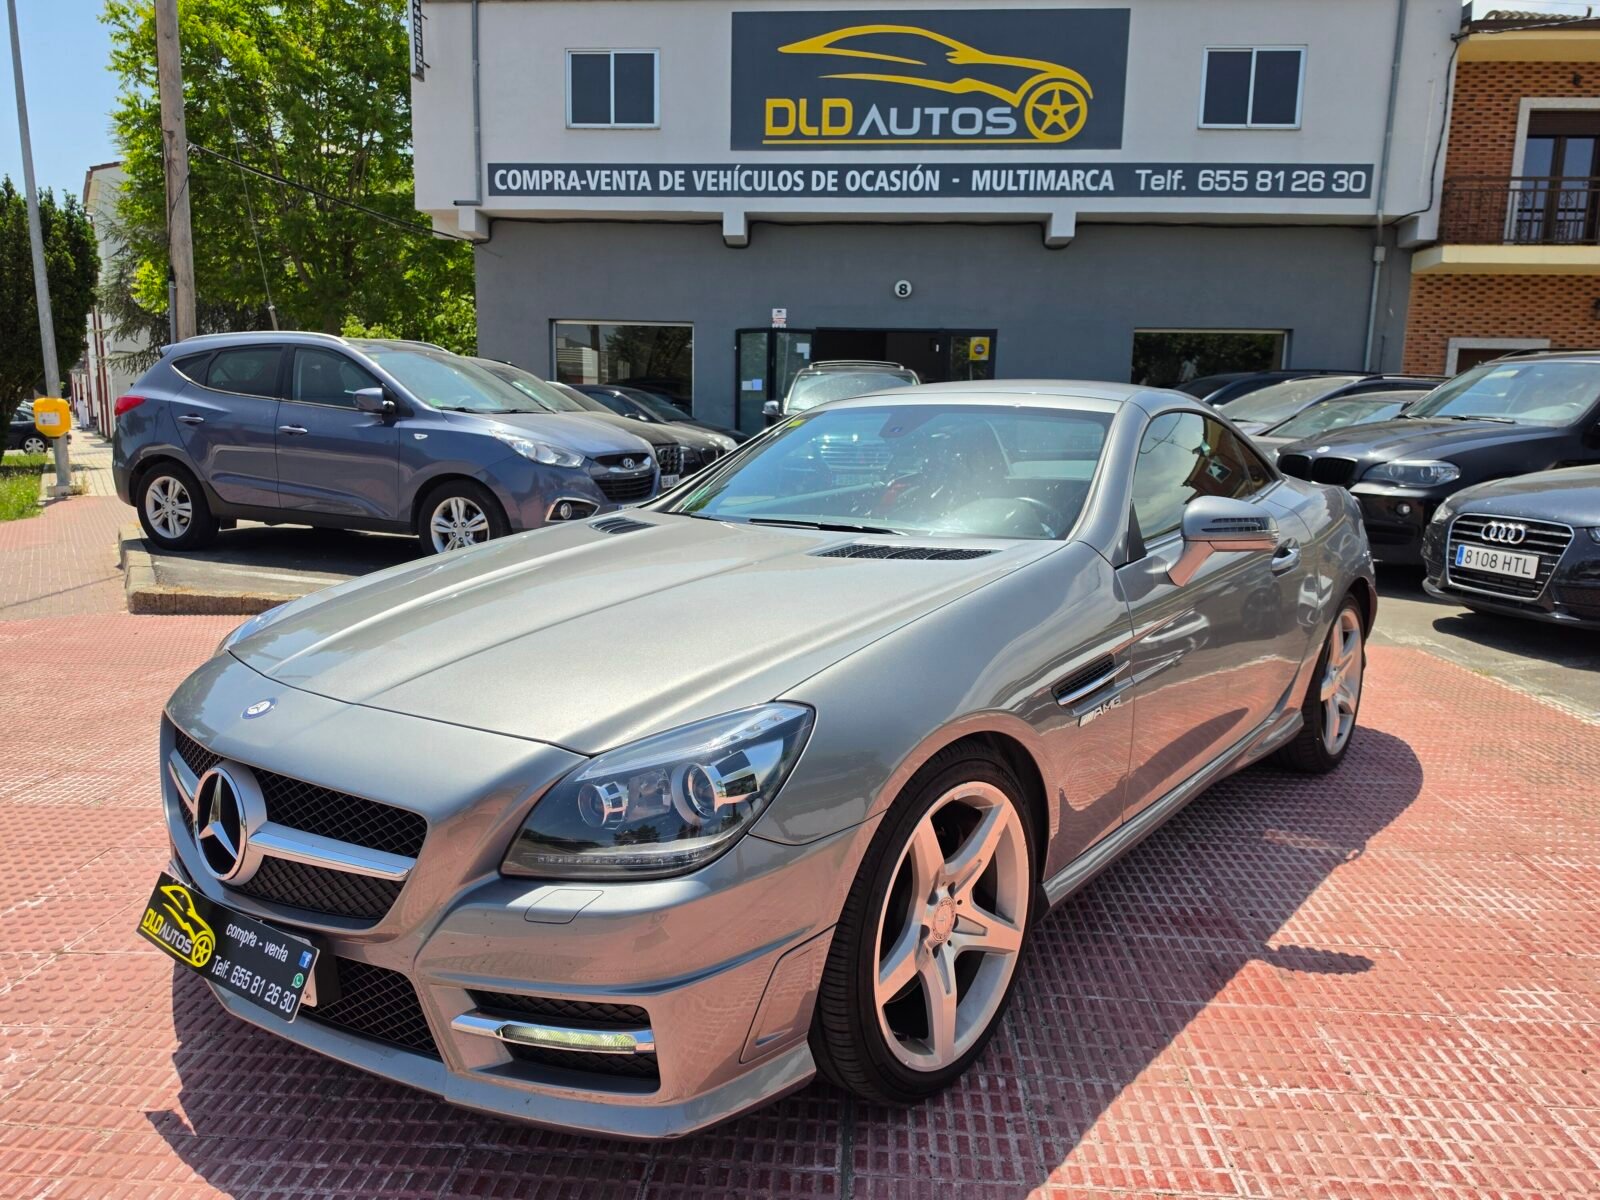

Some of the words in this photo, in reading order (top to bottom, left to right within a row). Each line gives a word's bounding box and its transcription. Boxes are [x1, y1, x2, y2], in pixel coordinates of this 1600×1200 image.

[765, 98, 853, 136] DLD
[857, 104, 1017, 136] AUTOS
[494, 169, 652, 191] COMPRA-VENTA
[658, 170, 685, 191] DE
[692, 165, 805, 191] VEHÍCULOS
[811, 170, 838, 191] DE
[845, 165, 940, 191] OCASIÓN
[971, 169, 1115, 191] MULTIMARCA
[1135, 169, 1187, 191] Telf.
[1198, 169, 1248, 192] 655
[1255, 170, 1285, 192] 81
[1290, 170, 1326, 192] 26
[1331, 170, 1367, 192] 30
[898, 283, 908, 296] 8
[1464, 549, 1498, 569] 8108
[1502, 555, 1531, 575] HTL
[143, 908, 165, 935] DLD
[158, 922, 193, 954] AUTOS
[226, 923, 258, 948] compra
[264, 941, 289, 962] venta
[211, 955, 231, 979] Telf.
[230, 965, 253, 990] 655
[250, 975, 266, 997] 81
[264, 982, 282, 1005] 26
[280, 990, 297, 1014] 30
